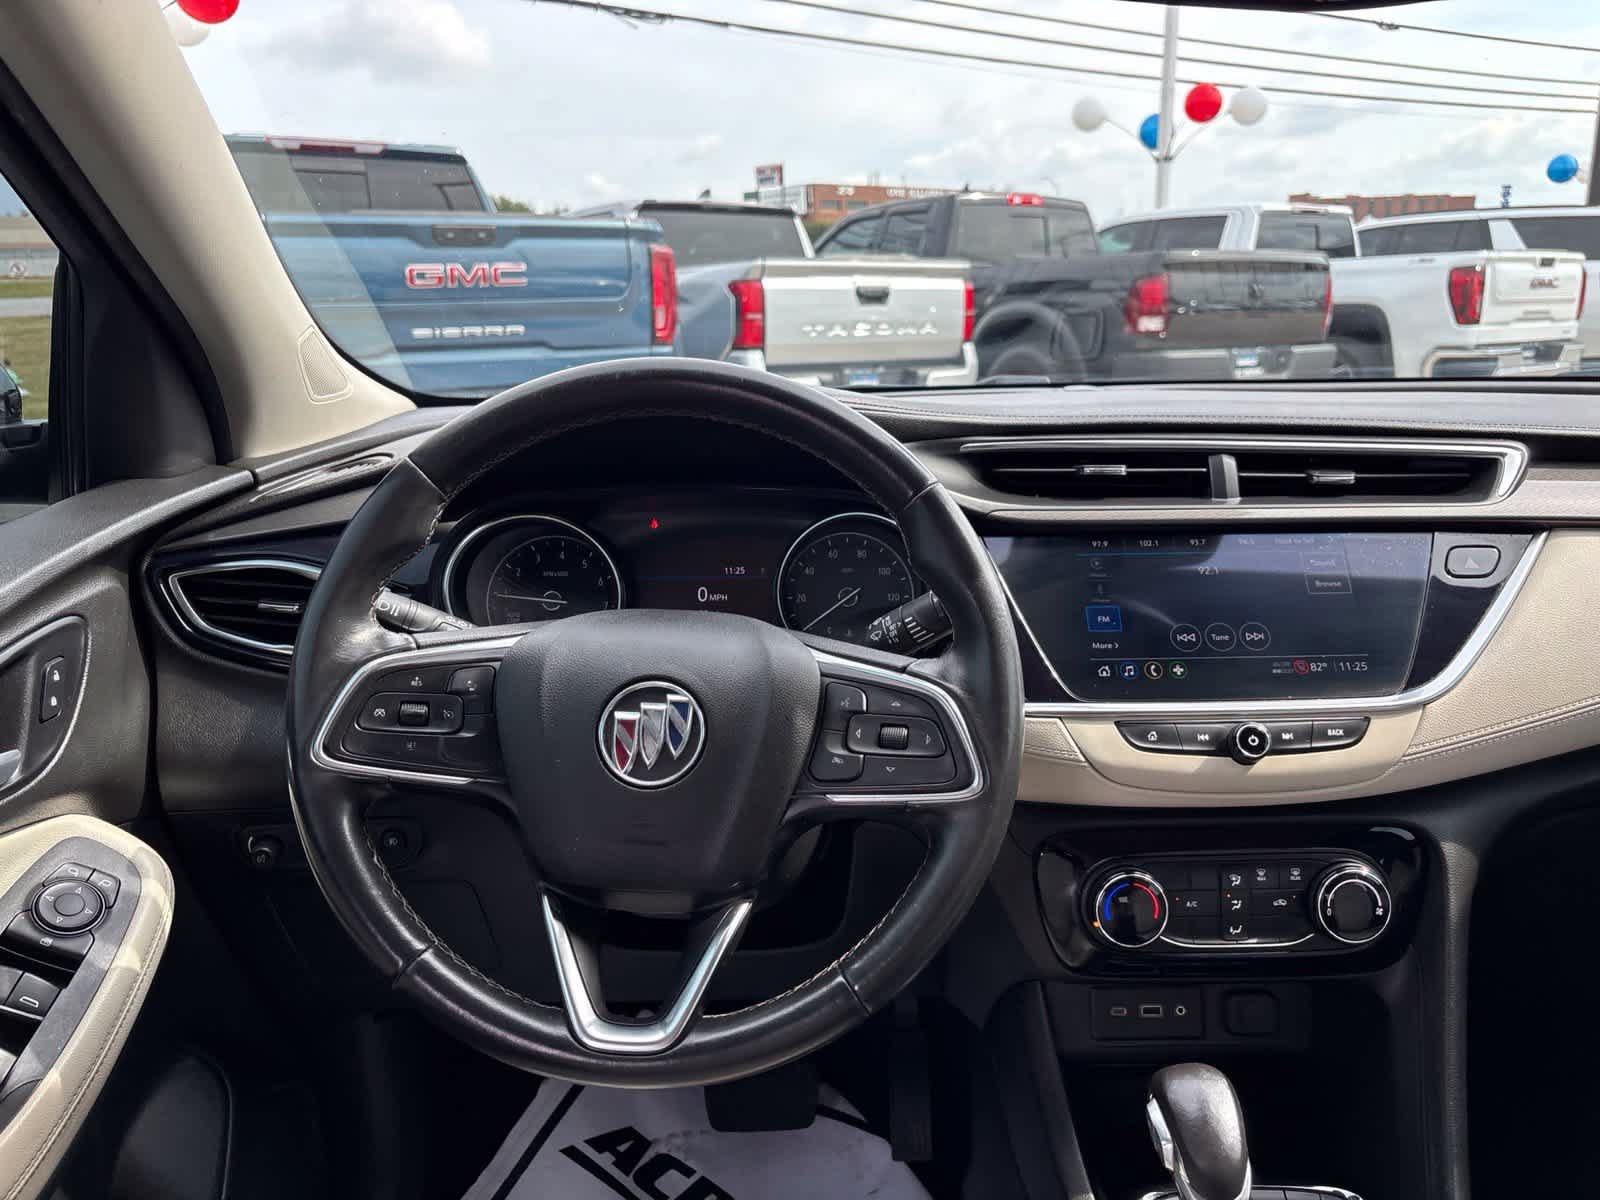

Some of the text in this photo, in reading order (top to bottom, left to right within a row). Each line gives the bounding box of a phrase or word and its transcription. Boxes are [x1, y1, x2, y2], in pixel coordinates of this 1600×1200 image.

[405, 262, 528, 289] GMC
[725, 566, 745, 575] 11:25
[697, 586, 728, 602] 0 MPH
[1097, 615, 1111, 623] FM
[1092, 642, 1113, 650] More
[1339, 661, 1368, 672] 11:25
[1327, 728, 1344, 737] BACK
